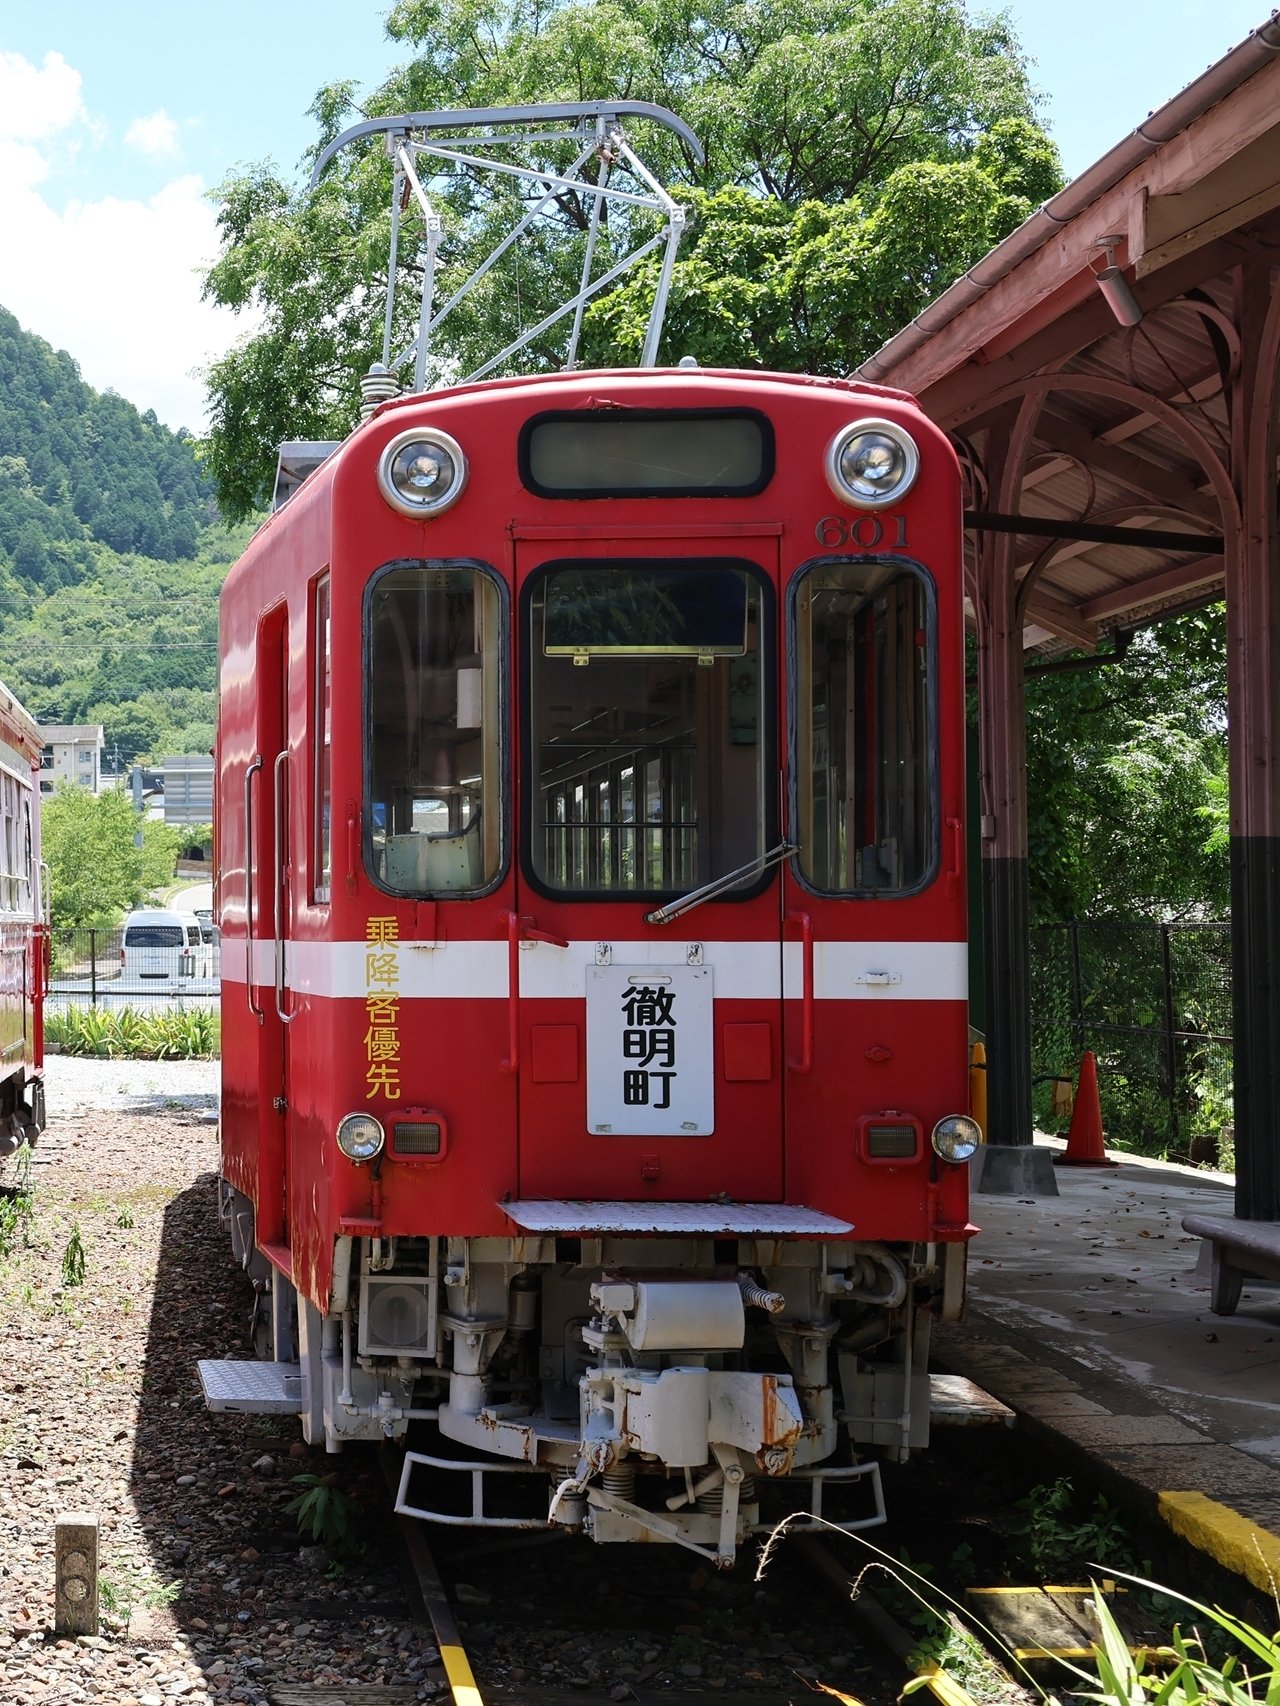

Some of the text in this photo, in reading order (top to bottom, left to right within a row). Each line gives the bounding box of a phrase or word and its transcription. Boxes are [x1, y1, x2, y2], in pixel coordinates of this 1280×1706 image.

[815, 516, 911, 547] 601
[364, 915, 401, 1100] 乗降客優先
[621, 986, 676, 1108] 徹明町
